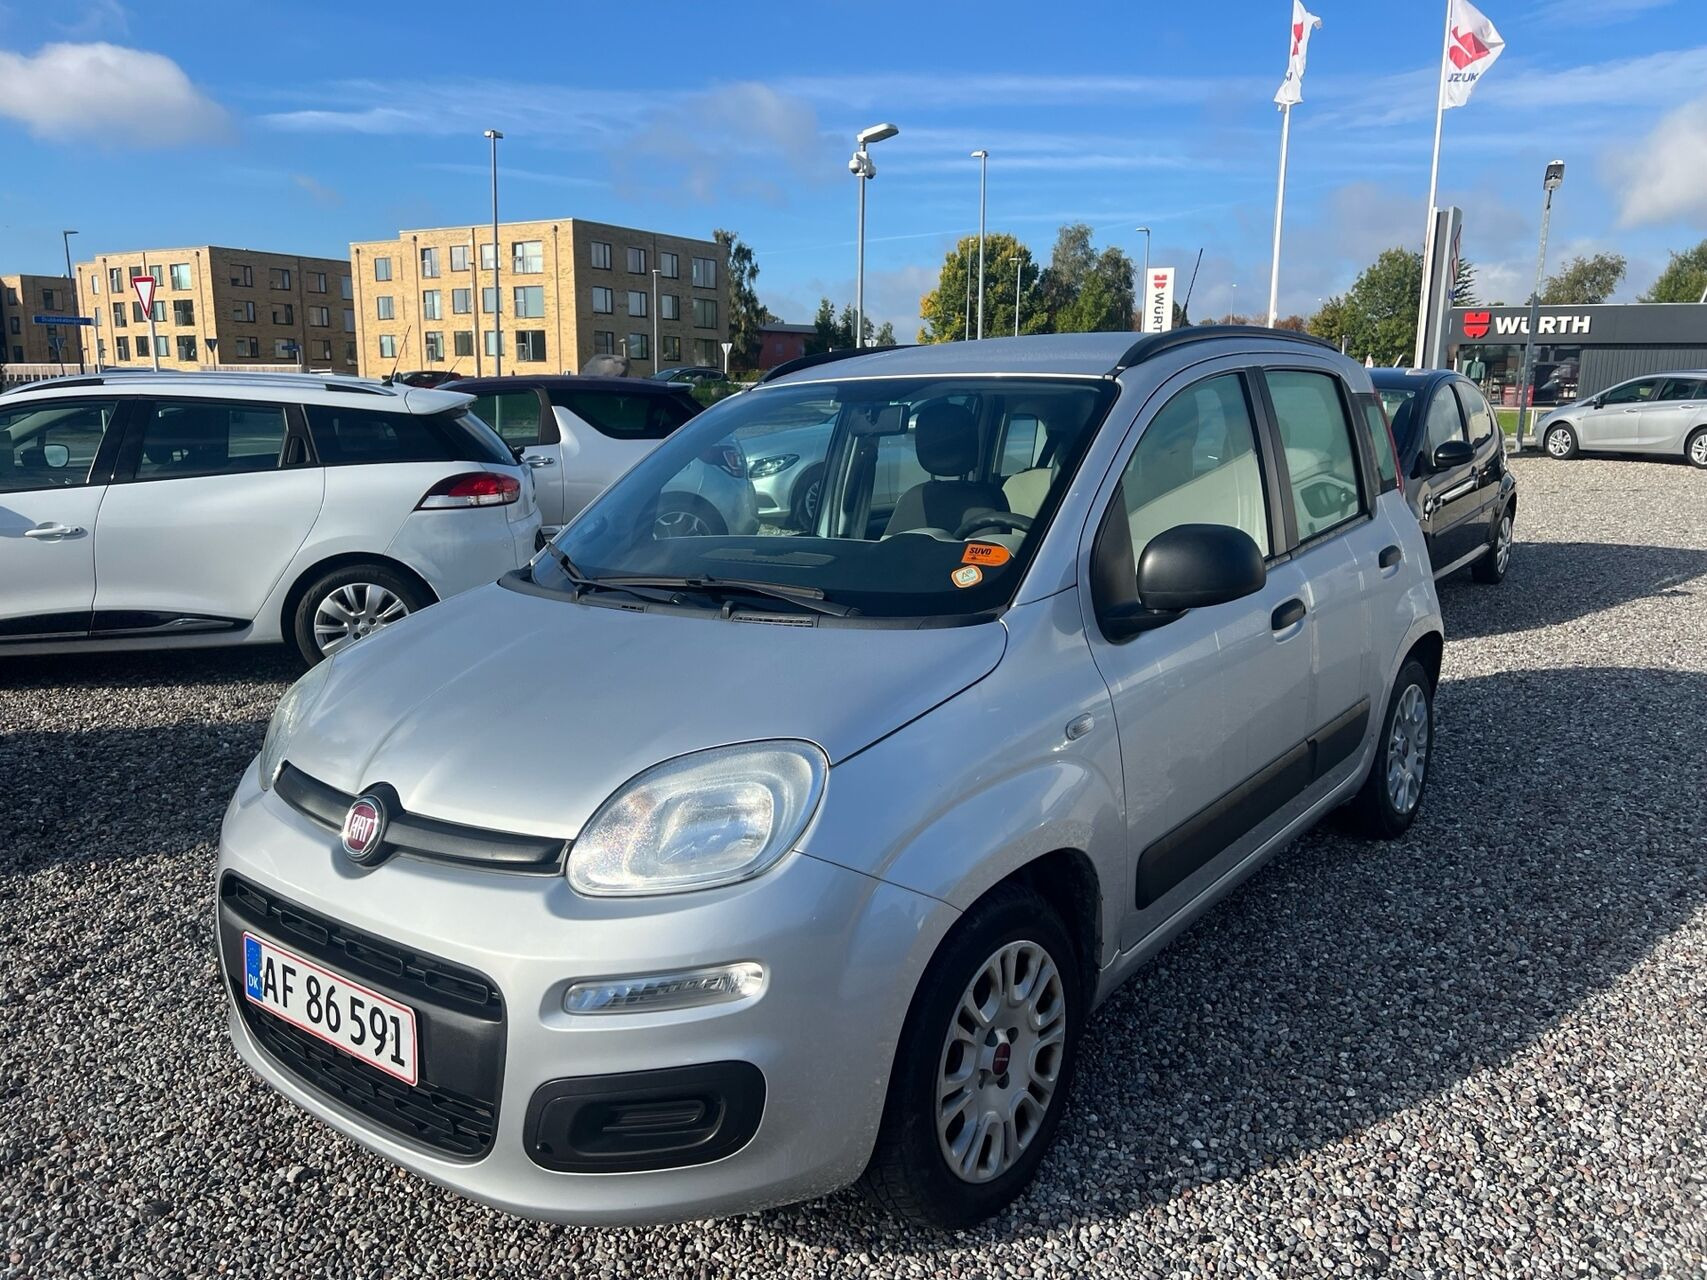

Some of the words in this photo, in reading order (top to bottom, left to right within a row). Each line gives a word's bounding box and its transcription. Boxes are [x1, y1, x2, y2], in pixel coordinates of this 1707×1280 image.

[1153, 292, 1165, 333] WÜRT
[248, 973, 259, 990] DK
[263, 956, 297, 1008] AF
[306, 975, 341, 1033] 86
[350, 995, 405, 1068] 591
